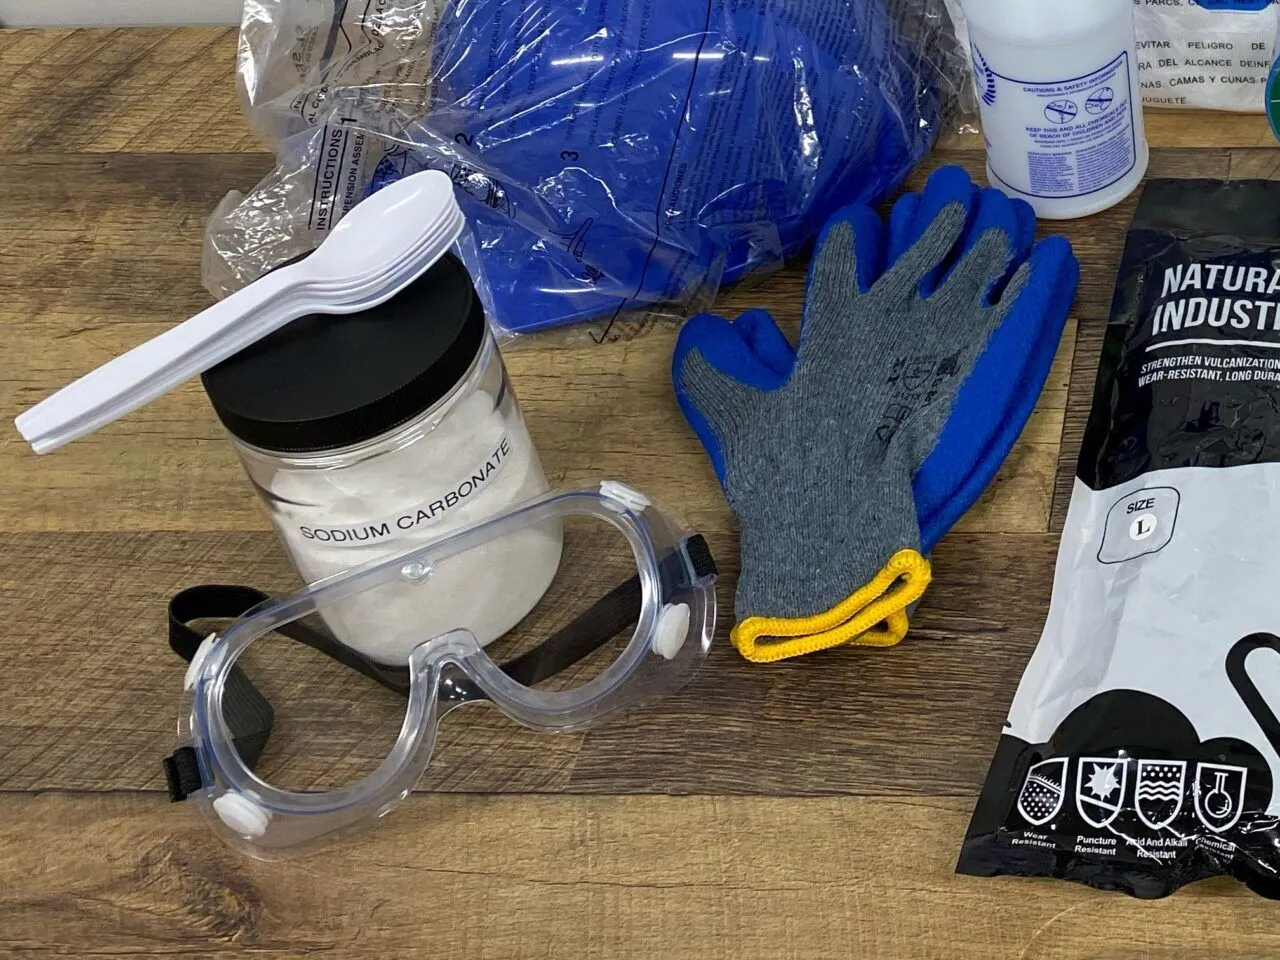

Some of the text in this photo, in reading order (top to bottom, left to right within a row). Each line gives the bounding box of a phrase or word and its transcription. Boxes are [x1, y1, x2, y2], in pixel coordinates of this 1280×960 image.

[1136, 40, 1266, 51] EVITAR PELIGRO DE
[1158, 58, 1233, 68] DEL ALCANCE
[1064, 81, 1087, 91] SAFETY
[1169, 76, 1256, 87] CAMAS Y CUNAS
[454, 132, 475, 147] 2
[560, 150, 580, 162] 3
[316, 129, 343, 230] INSTRUCTIONS
[1141, 355, 1202, 374] STRENGTHEN
[1138, 370, 1224, 388] WEAR-RESISTANT,
[1225, 371, 1251, 382] LONG
[299, 437, 511, 543] SODIUM CARBONATE
[1125, 497, 1156, 515] SIZE
[1136, 518, 1152, 536] L
[1023, 831, 1049, 841] Wear
[1076, 835, 1117, 846] Puncture
[1011, 838, 1056, 849] Resistant
[1146, 837, 1164, 847] And
[1164, 837, 1188, 848] Alkali
[1074, 845, 1117, 856] Resistant
[1136, 849, 1177, 860] Resistant
